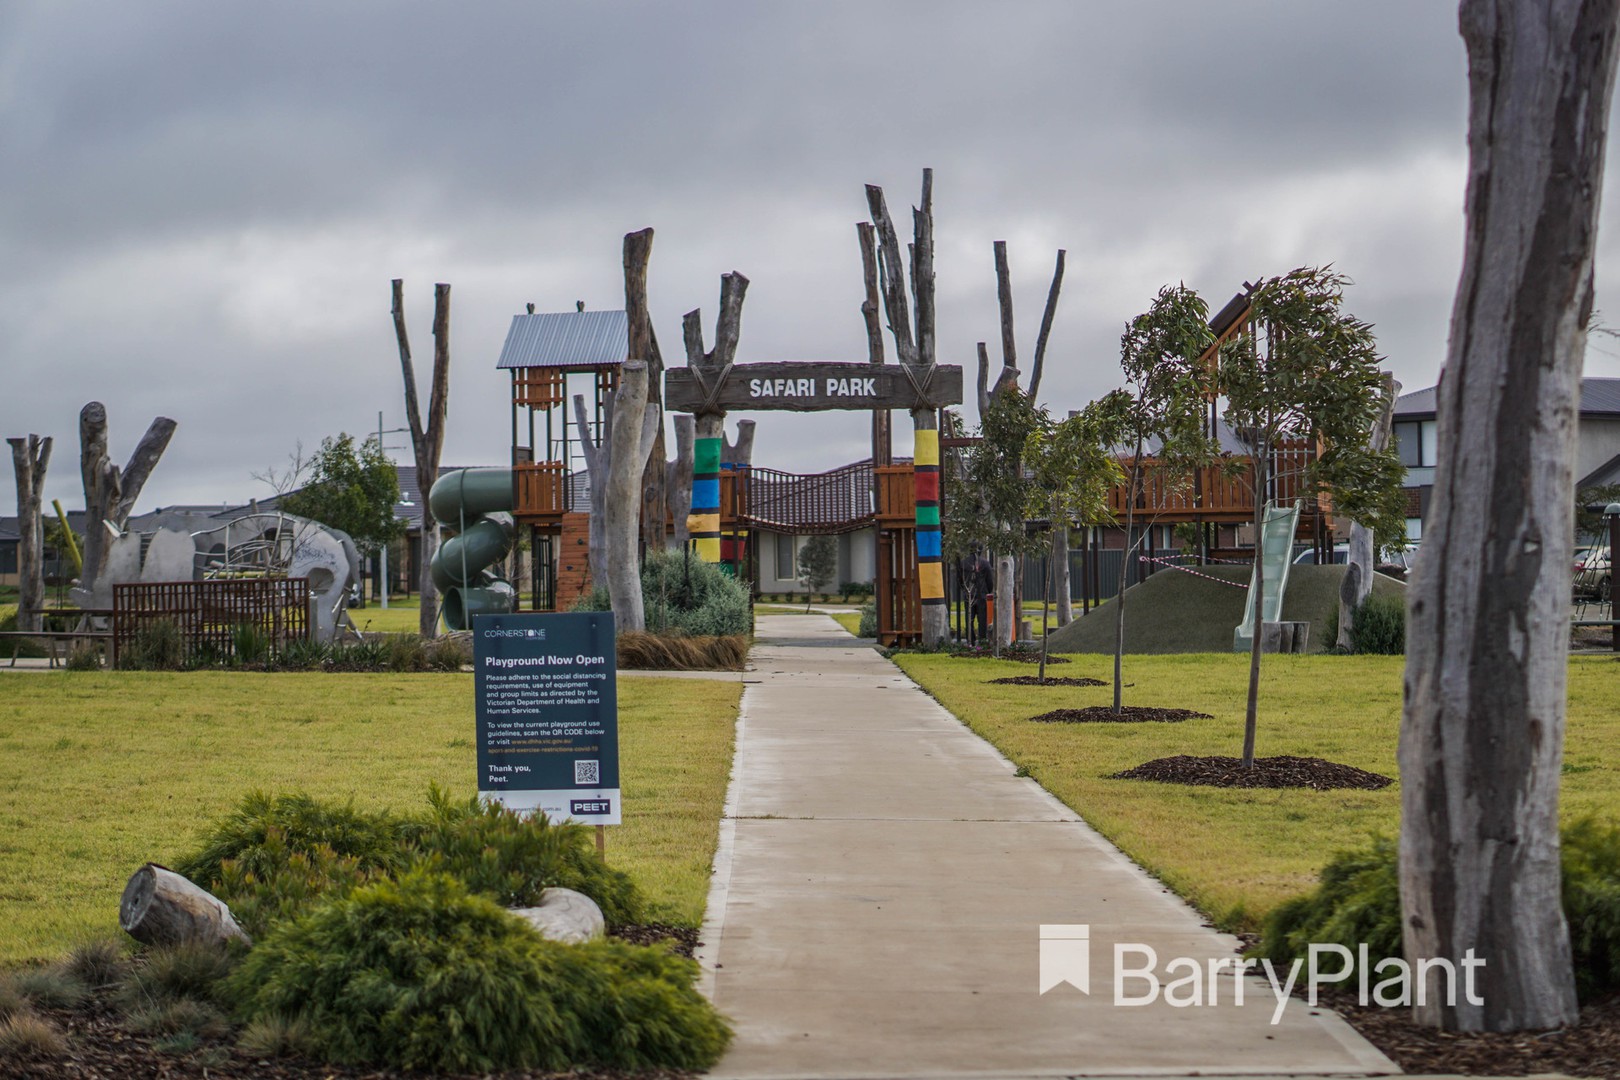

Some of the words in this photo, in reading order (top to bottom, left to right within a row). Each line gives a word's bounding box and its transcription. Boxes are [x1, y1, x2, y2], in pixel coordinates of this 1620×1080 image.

[749, 378, 815, 397] SAFARI
[826, 378, 877, 397] PARK
[486, 656, 545, 668] Playground
[548, 656, 573, 665] Now
[576, 655, 604, 666] Open
[574, 803, 608, 811] PEET
